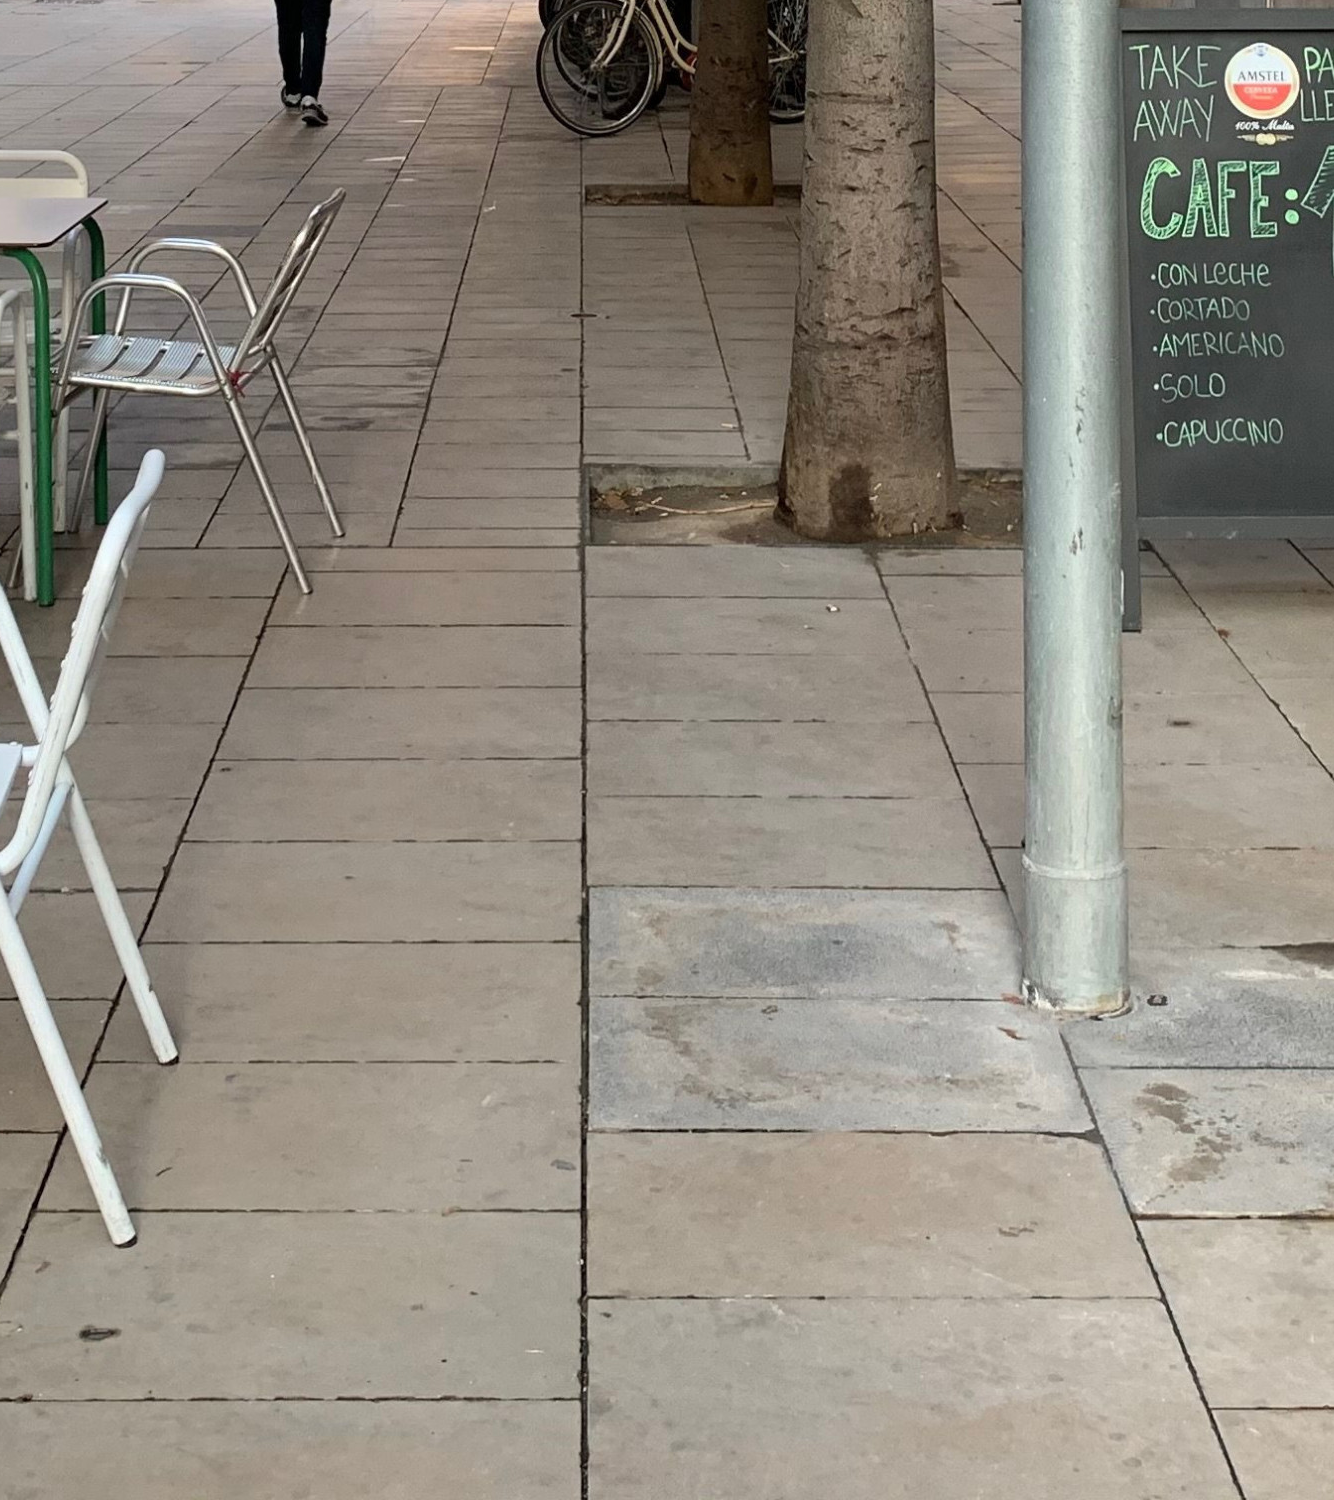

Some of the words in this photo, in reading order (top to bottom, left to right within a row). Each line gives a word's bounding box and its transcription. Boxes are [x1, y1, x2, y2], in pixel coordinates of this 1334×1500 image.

[1129, 45, 1221, 90] TAKE
[1237, 70, 1285, 82] AMSTEL
[1133, 94, 1215, 143] AWAY
[1159, 331, 1285, 359] AMERICANO
[1160, 372, 1227, 404] SOLO
